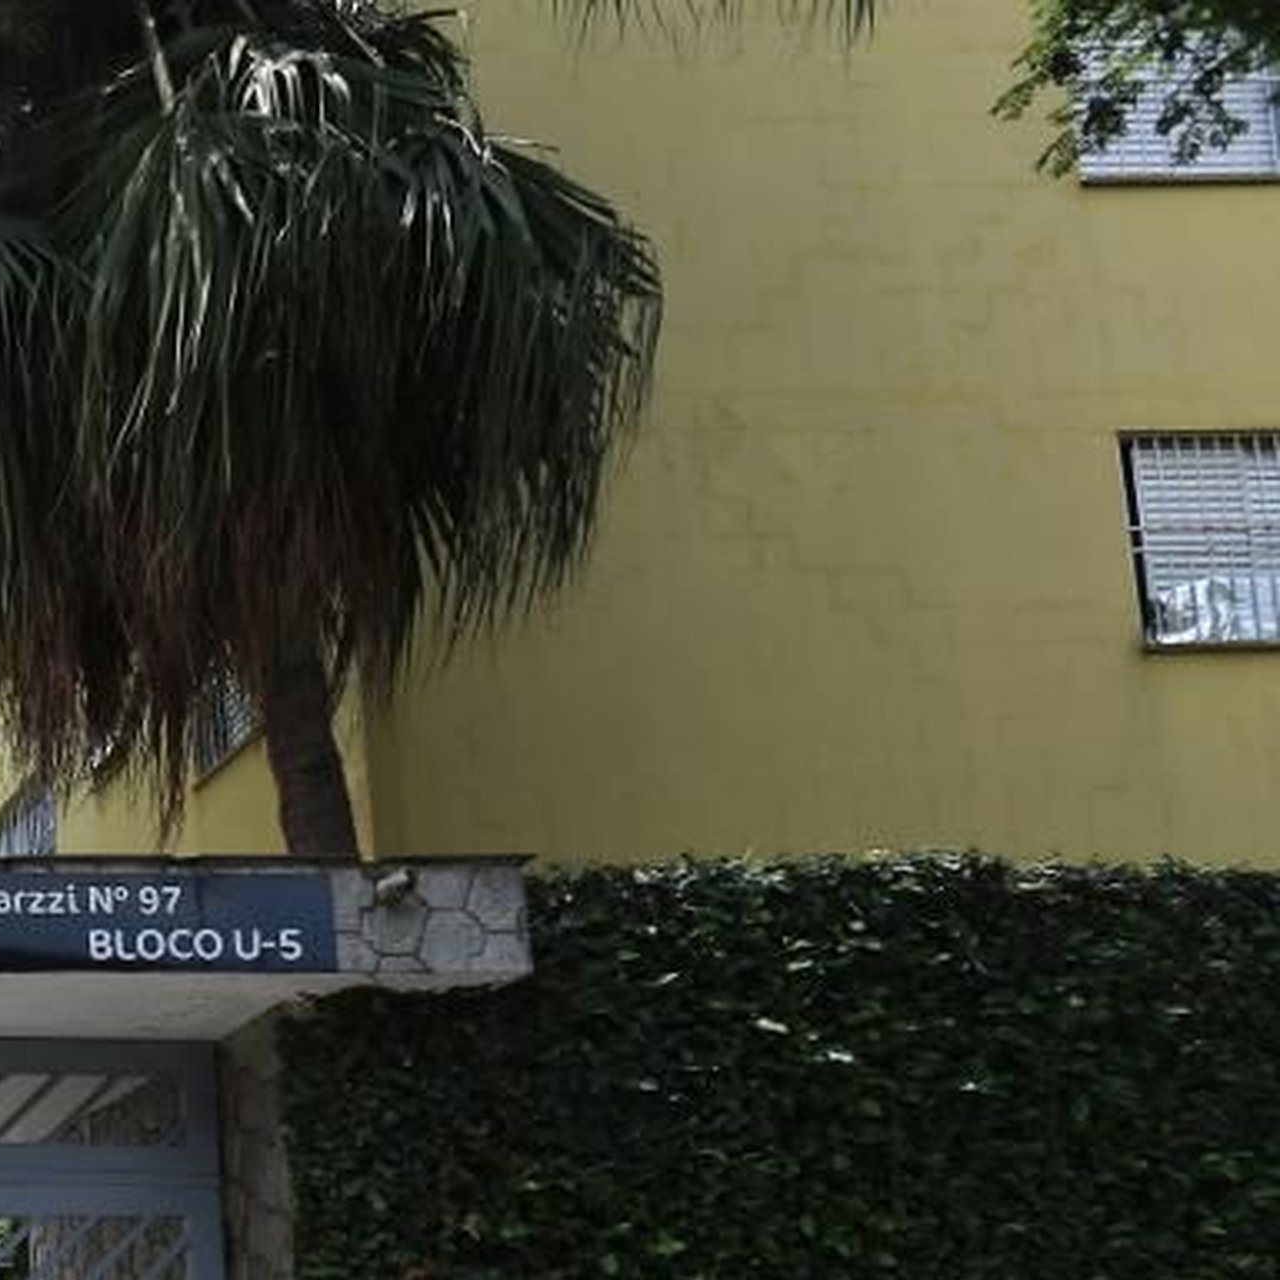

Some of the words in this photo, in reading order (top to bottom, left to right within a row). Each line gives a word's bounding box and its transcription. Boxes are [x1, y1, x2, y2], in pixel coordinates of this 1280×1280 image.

[139, 885, 182, 915] 97
[89, 927, 223, 961] BLOCO
[234, 928, 303, 961] U-5
